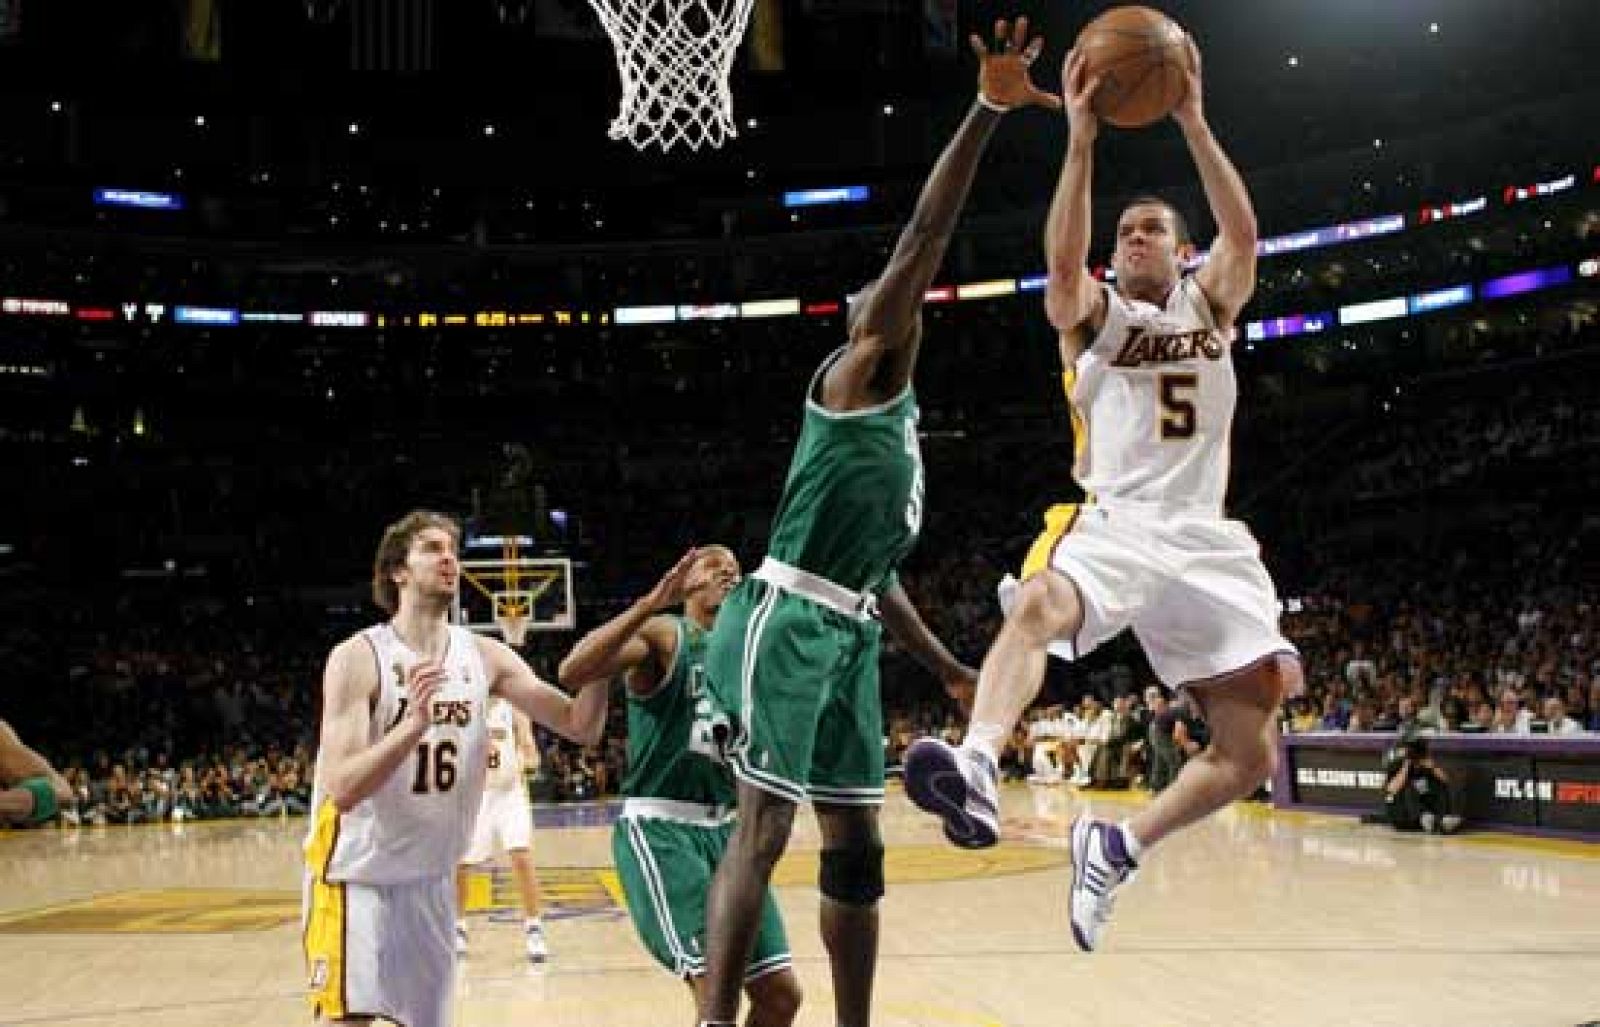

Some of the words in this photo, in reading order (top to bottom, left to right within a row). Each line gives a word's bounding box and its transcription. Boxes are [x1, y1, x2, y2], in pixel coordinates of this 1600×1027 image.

[1109, 326, 1223, 366] LAKERS
[1160, 372, 1199, 441] 5
[413, 740, 457, 793] 16
